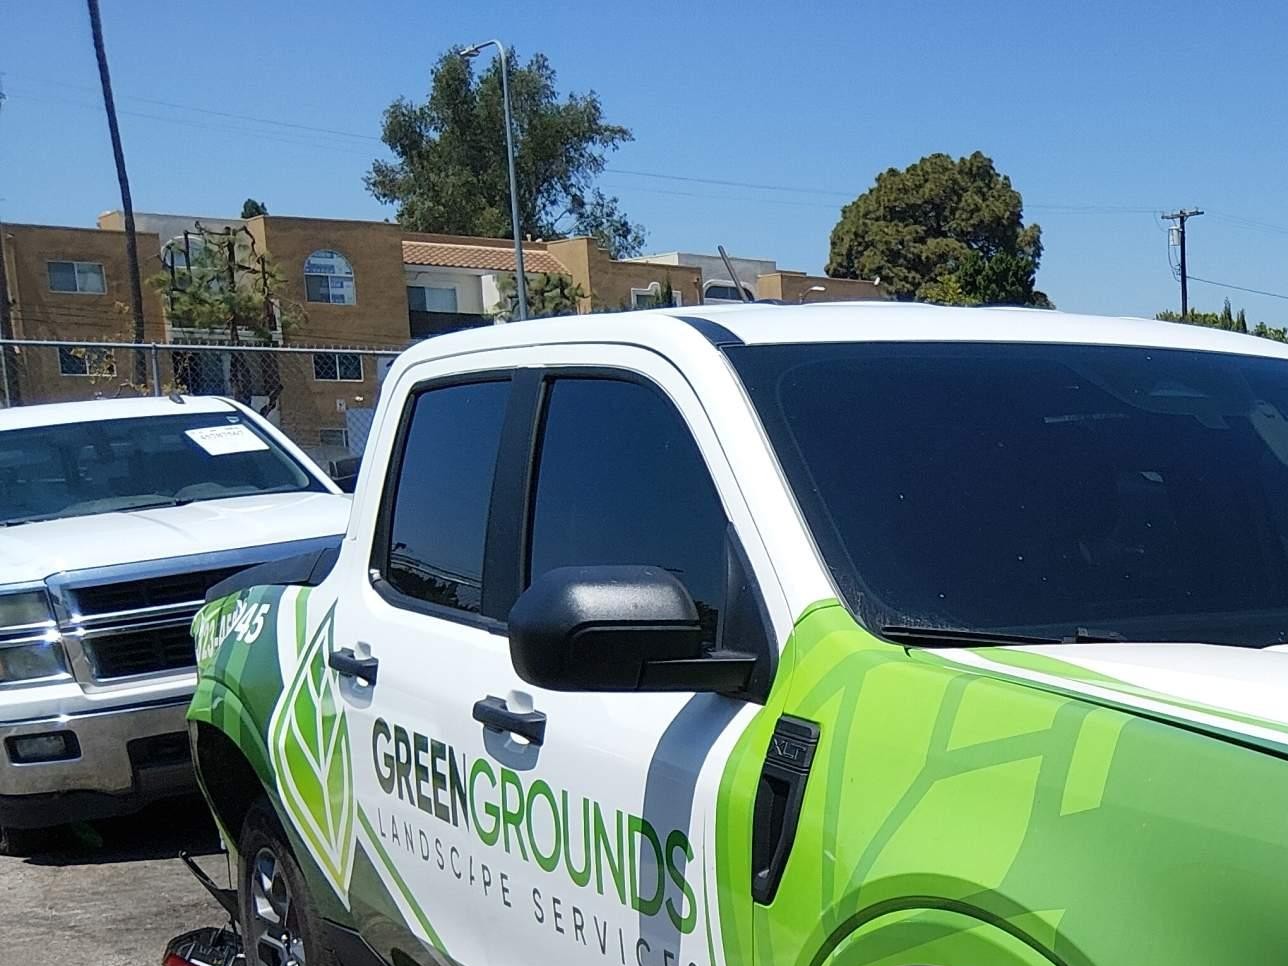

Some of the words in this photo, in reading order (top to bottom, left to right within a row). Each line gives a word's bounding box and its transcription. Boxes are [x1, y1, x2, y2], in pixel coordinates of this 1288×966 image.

[773, 738, 807, 760] XLT
[372, 717, 698, 935] GREENGROUNDS
[377, 807, 512, 909] LANDSCAPE
